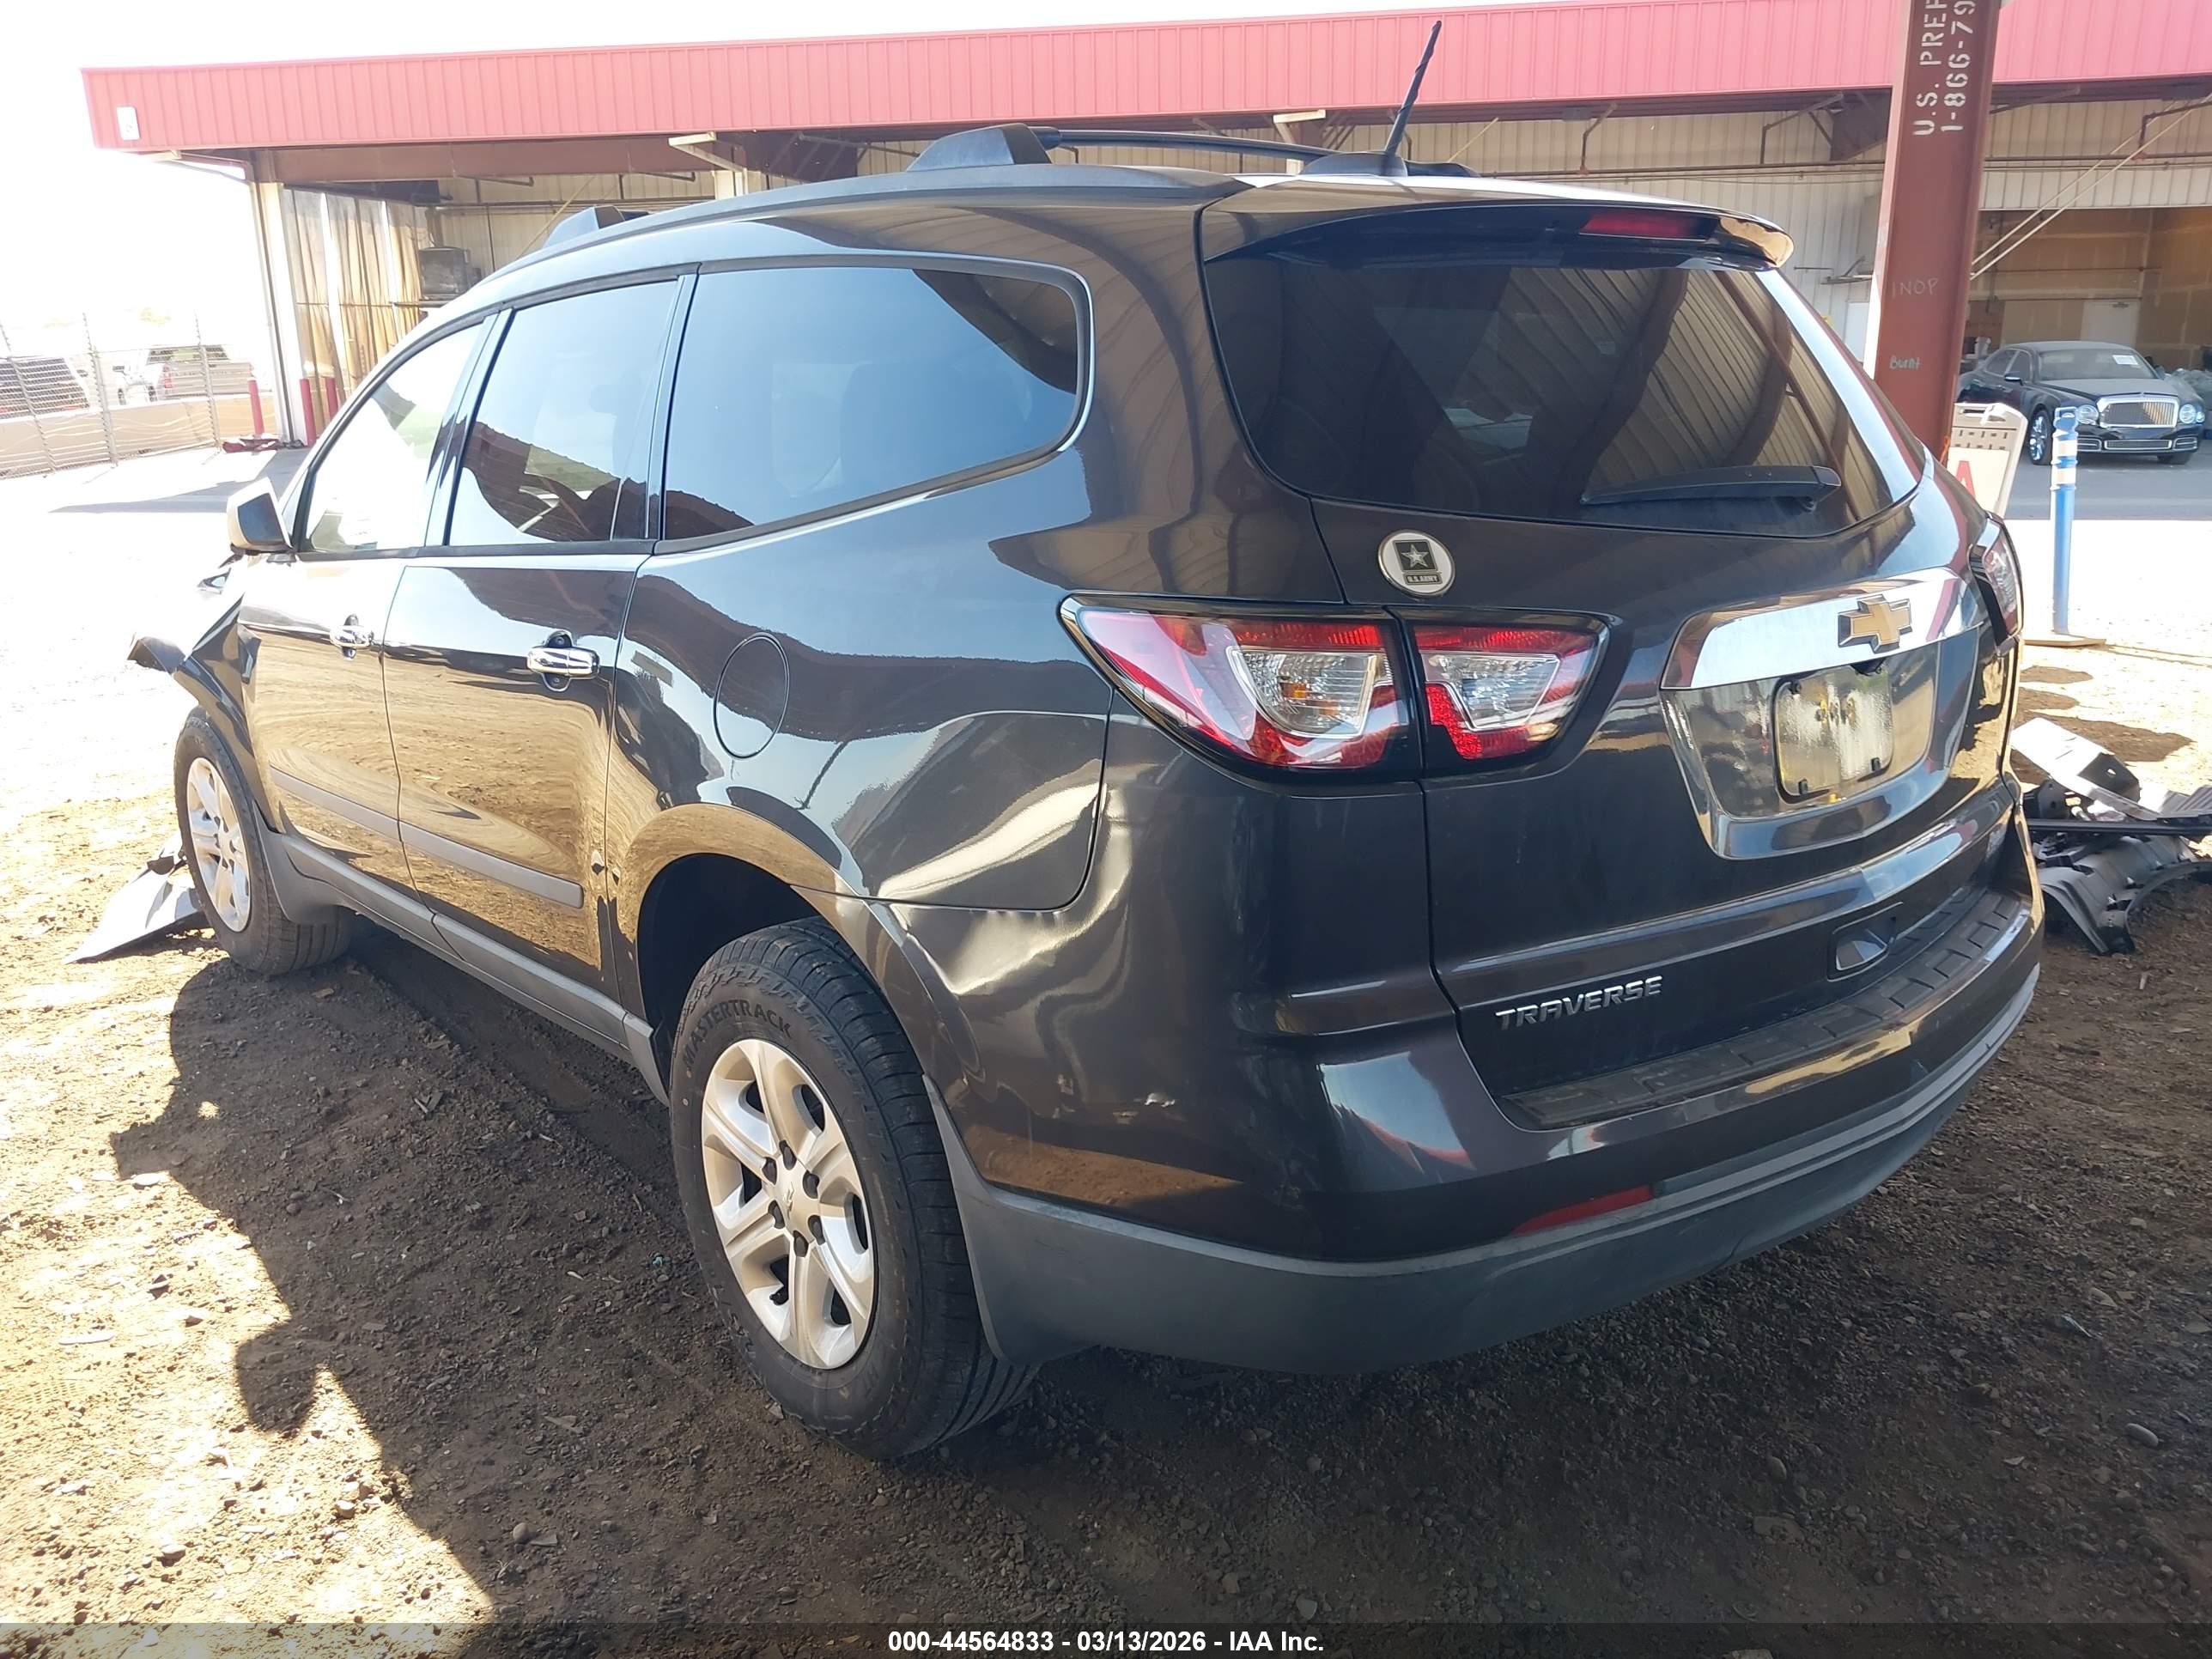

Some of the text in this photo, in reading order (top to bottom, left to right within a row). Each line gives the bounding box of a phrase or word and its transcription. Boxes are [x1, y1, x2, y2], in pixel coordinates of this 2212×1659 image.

[1912, 83, 1939, 136] U.S.
[1495, 975, 1663, 1030] TRAVERSE
[683, 999, 792, 1072] MASTERTRACK
